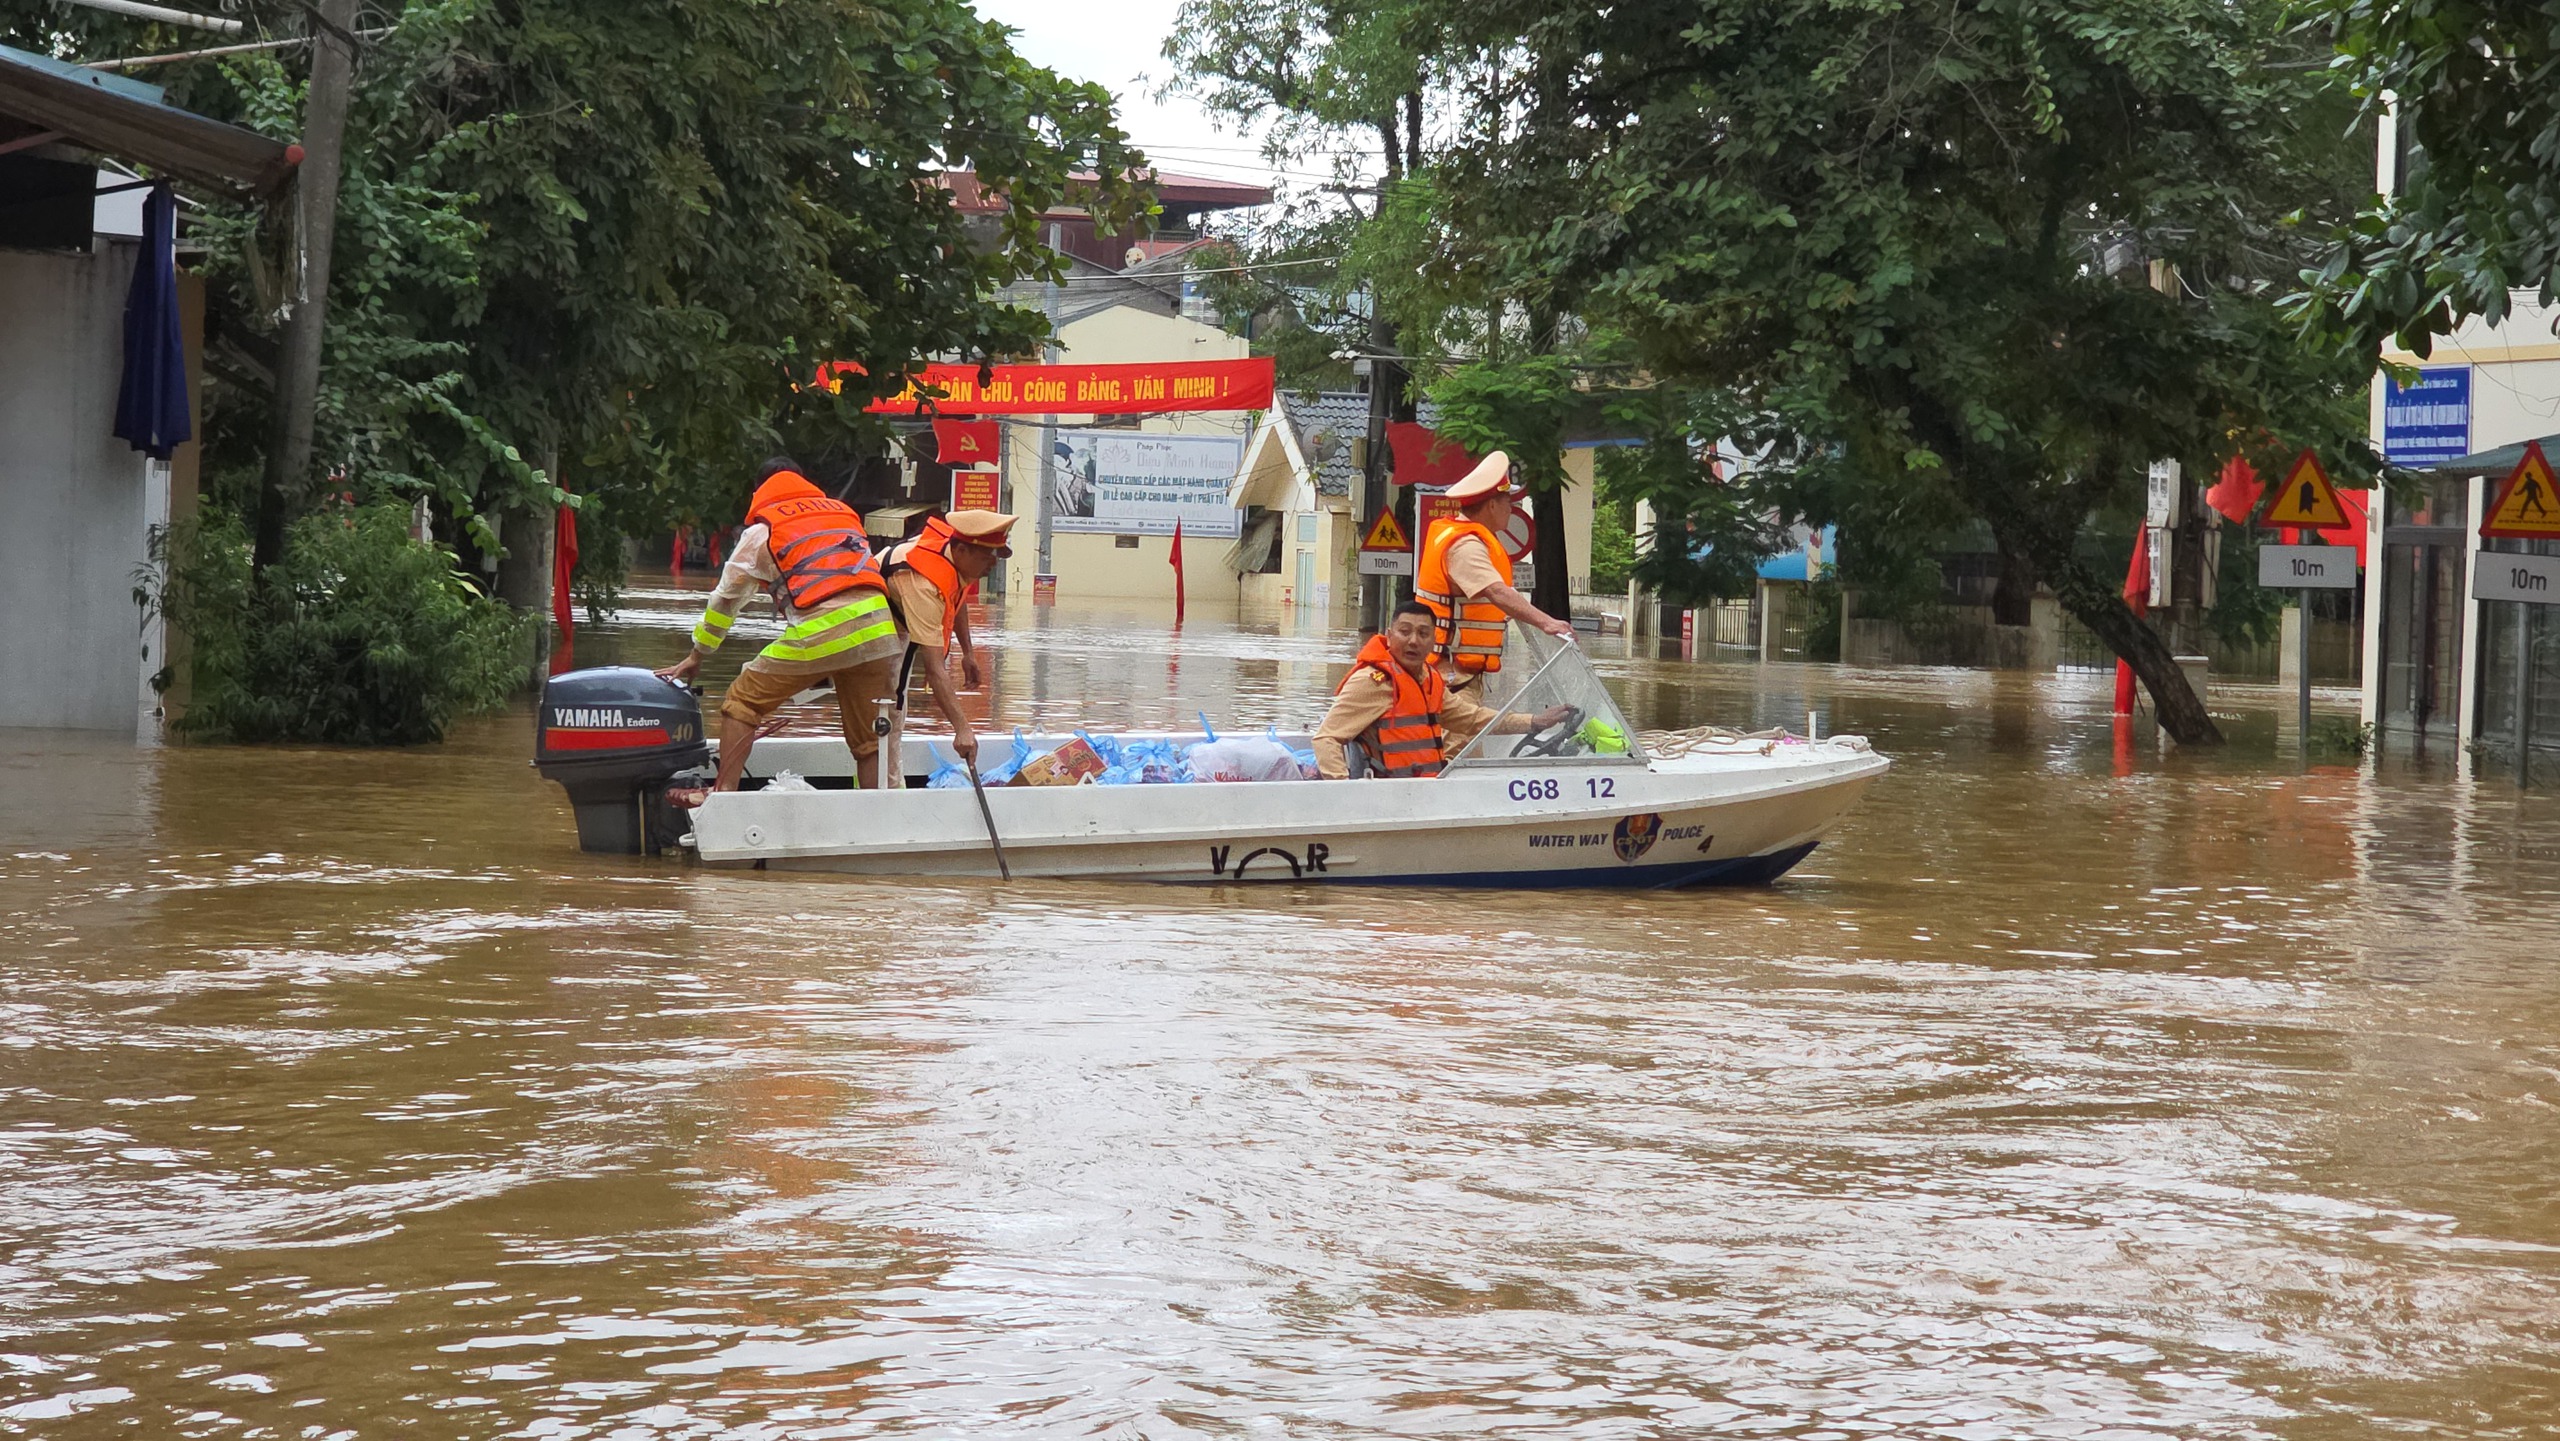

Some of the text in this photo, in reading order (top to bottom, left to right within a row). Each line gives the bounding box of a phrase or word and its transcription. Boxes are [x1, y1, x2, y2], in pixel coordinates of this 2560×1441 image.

[1023, 377, 1066, 402] CÔNG
[1134, 375, 1165, 400] VĂN
[1173, 376, 1216, 399] MINH
[1374, 558, 1398, 569] 100m
[2291, 558, 2324, 577] 10m
[2511, 567, 2547, 591] 10m
[555, 708, 660, 728] YAMAHA Enduro
[672, 723, 694, 743] 40
[1508, 777, 1616, 801] C68 12
[1529, 825, 1706, 848] WATER WAY POLICE
[1696, 834, 1714, 853] 4
